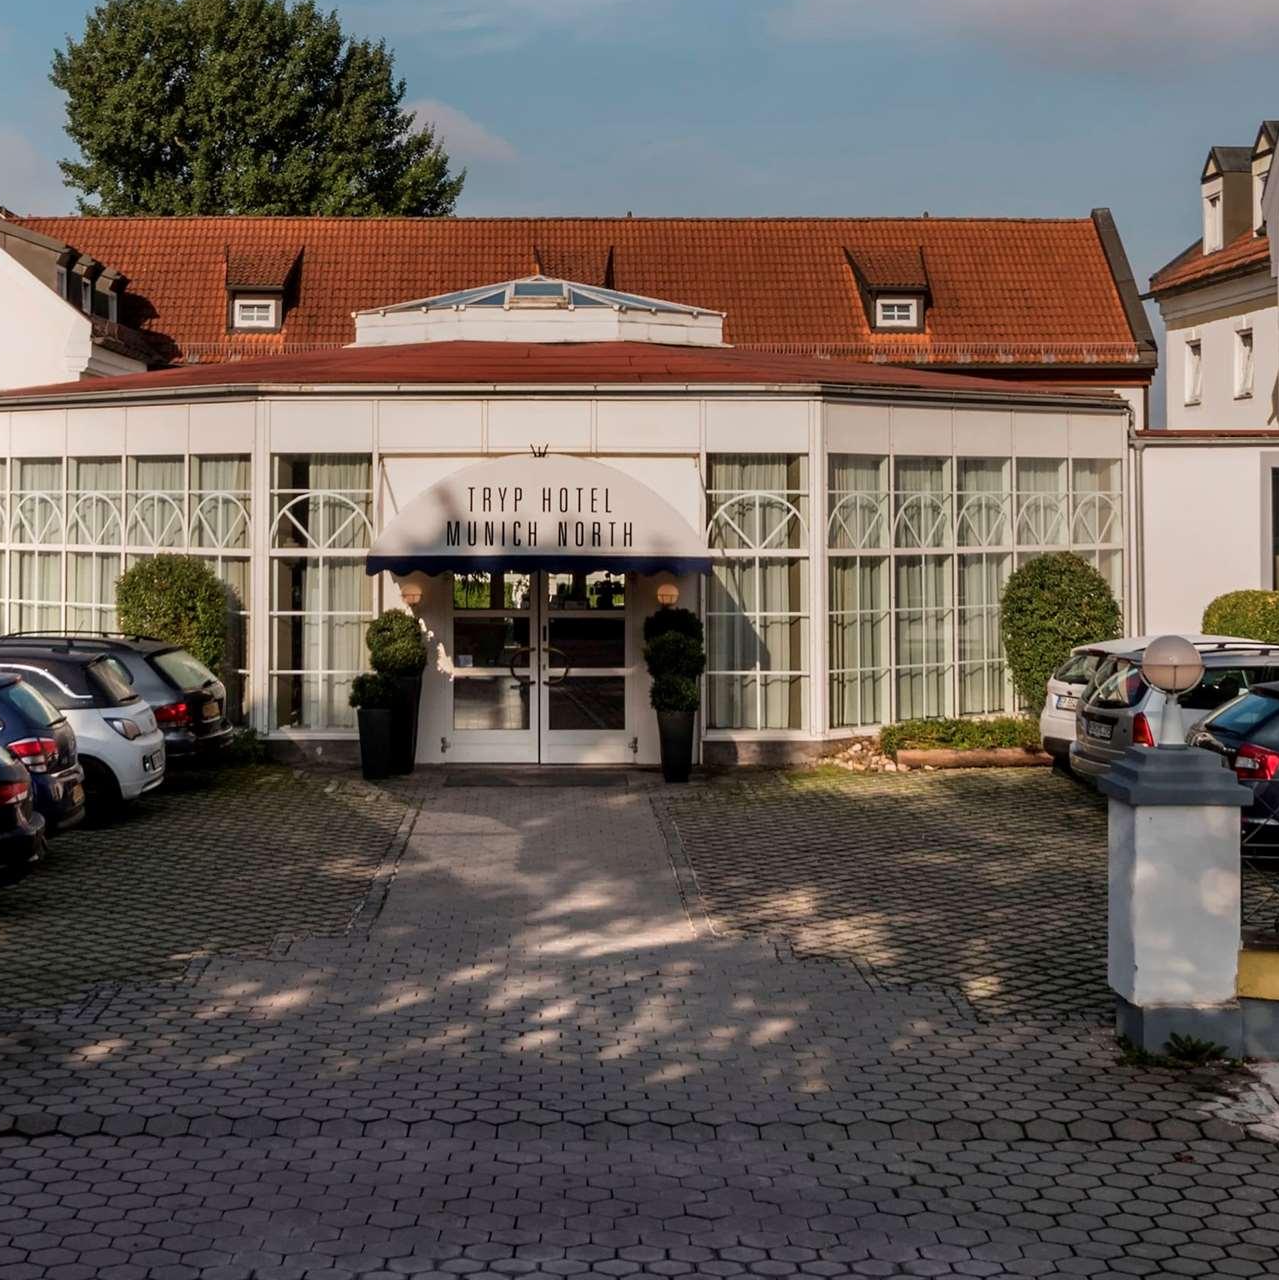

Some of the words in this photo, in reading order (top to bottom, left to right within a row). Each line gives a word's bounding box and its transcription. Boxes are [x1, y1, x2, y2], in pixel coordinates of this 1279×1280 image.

[468, 487, 523, 513] TRYP
[542, 487, 612, 513] HOTEL
[446, 521, 538, 547] MUNICH
[558, 522, 634, 548] NORTH
